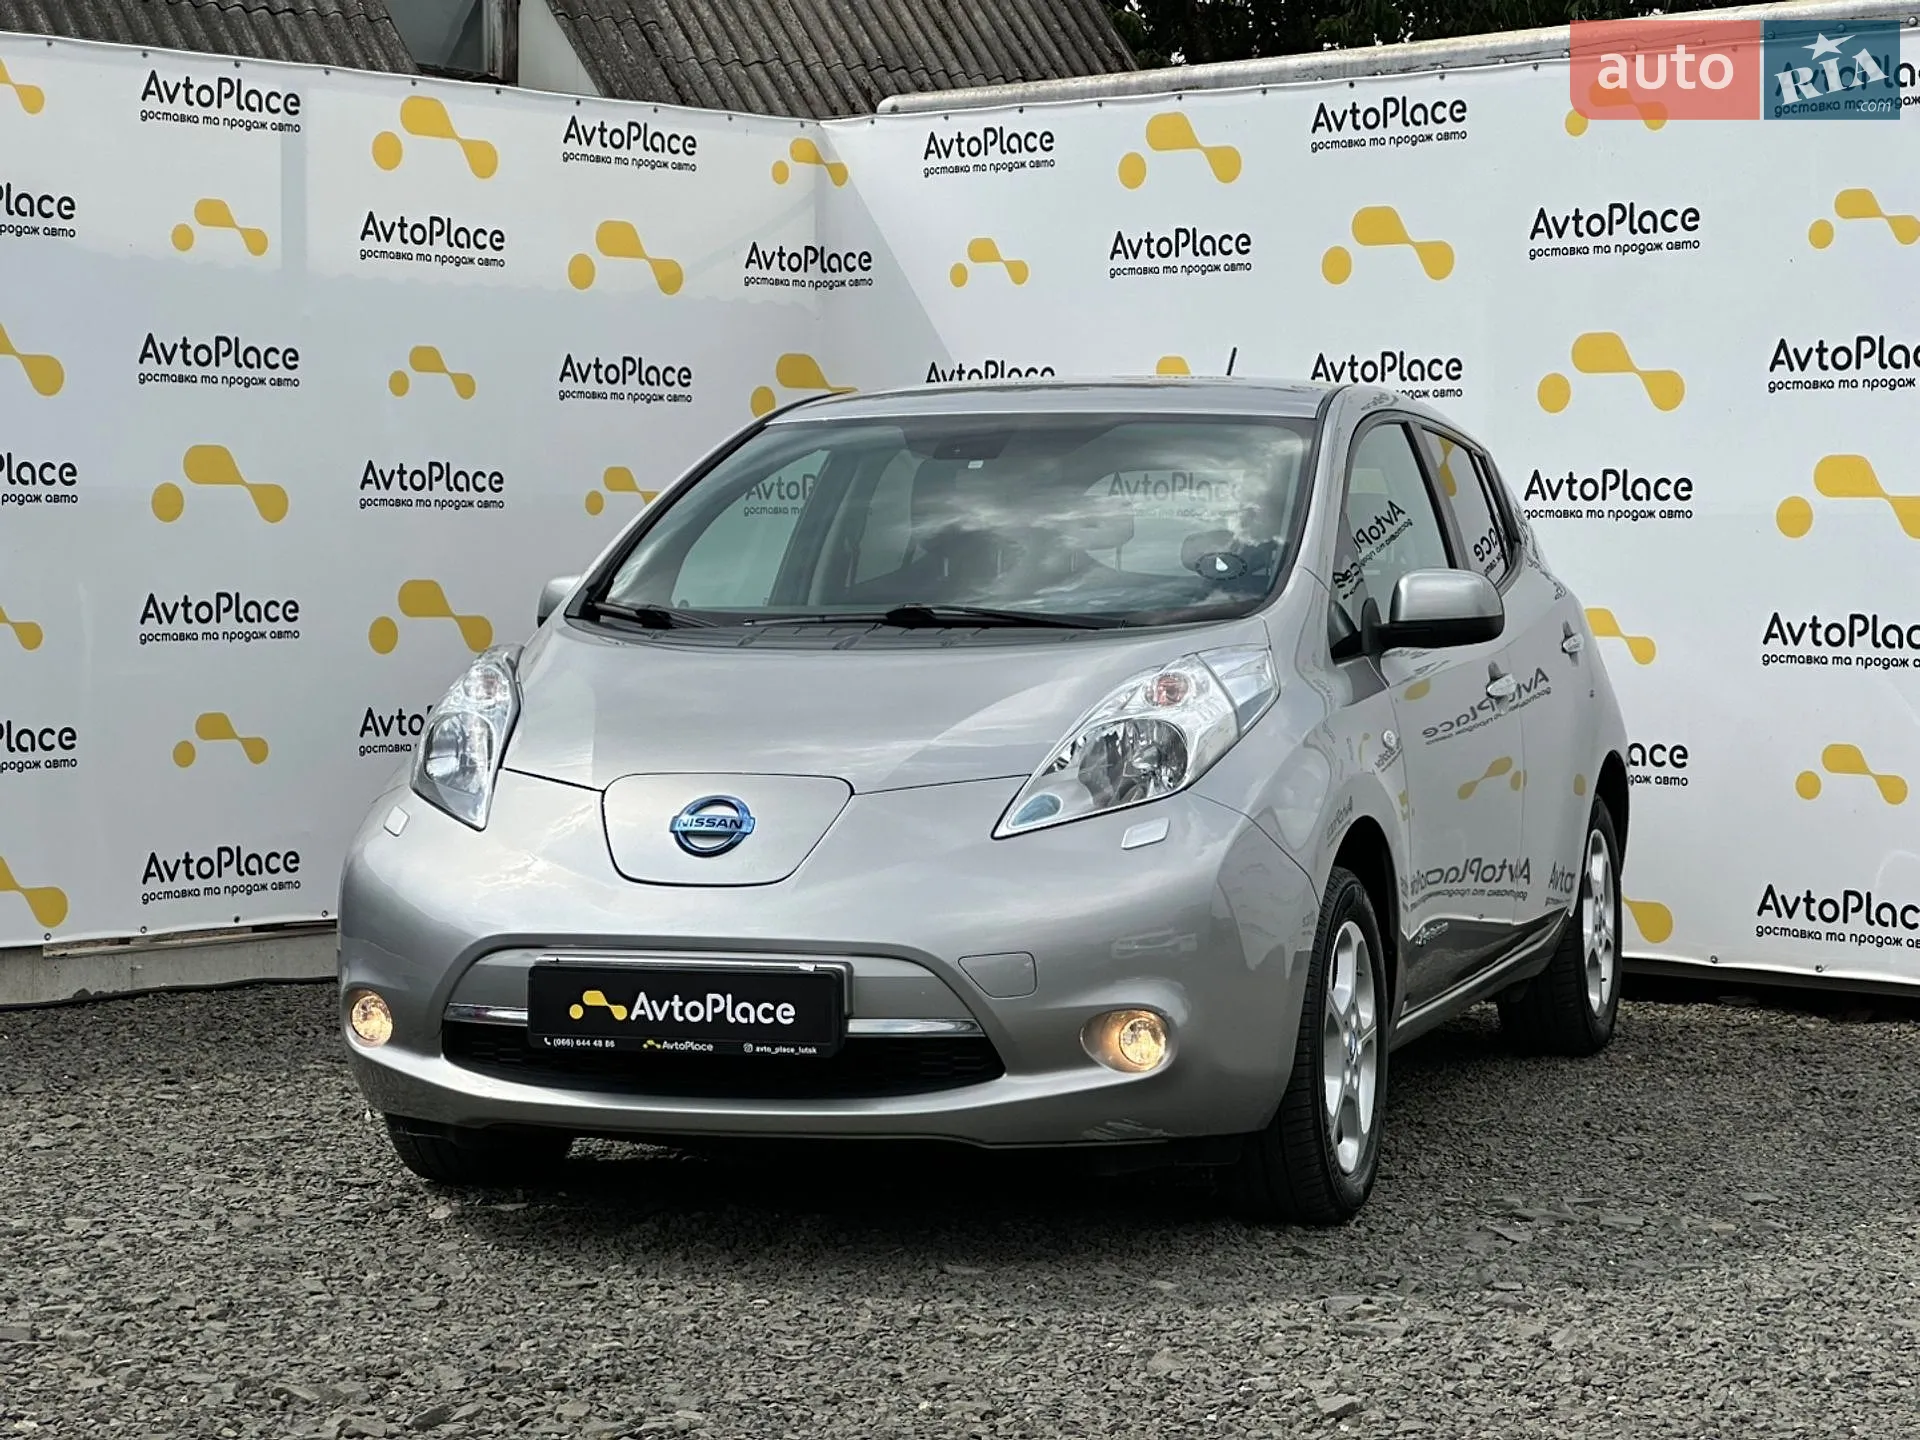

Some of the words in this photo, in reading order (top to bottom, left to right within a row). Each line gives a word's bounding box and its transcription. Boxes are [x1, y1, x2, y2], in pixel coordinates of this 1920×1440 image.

[141, 70, 300, 116] AvtoPlace
[139, 109, 199, 124] доставка
[202, 115, 219, 126] та
[222, 117, 267, 131] продаж
[269, 121, 301, 133] авто
[1311, 96, 1467, 134] AvtoPlace
[563, 115, 697, 156] AvtoPlace
[924, 126, 1054, 160] AvtoPlace
[1310, 137, 1366, 153] доставка
[1369, 136, 1386, 146] та
[1388, 133, 1433, 147] продаж
[1435, 129, 1467, 141] авто
[0, 182, 75, 220] lace
[42, 226, 75, 237] авто
[360, 211, 505, 251] AvtoPlace
[1530, 202, 1700, 240] AvtoPlace
[359, 248, 413, 261] доставка
[415, 252, 431, 262] та
[434, 254, 475, 267] продаж
[477, 257, 505, 267] авто
[745, 242, 872, 274] AvtoPlace
[1110, 227, 1251, 260] AvtoPlace
[1528, 245, 1589, 261] доставка
[1592, 244, 1611, 254] та
[1614, 241, 1663, 256] продаж
[1665, 239, 1700, 250] авто
[1109, 265, 1159, 279] доставка
[1162, 264, 1178, 274] та
[1180, 263, 1221, 275] продаж
[1222, 262, 1251, 271] авто
[139, 333, 299, 370] AvtoPlace
[137, 372, 197, 385] доставка
[200, 374, 218, 384] та
[220, 375, 266, 388] продаж
[268, 377, 299, 387] авто
[559, 353, 692, 387] AvtoPlace
[1311, 351, 1463, 383] AvtoPlace
[1431, 388, 1462, 398] авто
[1767, 379, 1834, 394] доставка
[1838, 378, 1858, 388] та
[1861, 377, 1915, 391] продаж
[0, 452, 77, 486] lace
[360, 460, 504, 493] AvtoPlace
[44, 493, 78, 503] авто
[1524, 469, 1693, 502] AvtoPlace
[359, 497, 413, 509] доставка
[415, 498, 431, 507] та
[433, 498, 474, 510] продаж
[476, 499, 504, 508] авто
[1586, 509, 1604, 518] та
[1607, 509, 1655, 521] продаж
[1658, 509, 1693, 518] авто
[140, 592, 299, 625] AvtoPlace
[138, 631, 198, 645] доставка
[201, 631, 219, 640] та
[222, 630, 266, 643] продаж
[269, 629, 299, 639] авто
[1761, 653, 1828, 666] доставка
[1831, 655, 1852, 666] та
[1855, 656, 1909, 670] продаж
[359, 705, 433, 738] Avto
[0, 720, 77, 753] lace
[358, 743, 411, 756] доставка
[43, 758, 77, 768] авто
[1654, 775, 1688, 786] авто
[677, 817, 743, 829] NISSAN
[142, 846, 300, 885] AvtoPlace
[141, 887, 200, 905] доставка
[203, 886, 220, 896] та
[223, 882, 268, 896] продаж
[270, 879, 301, 890] авто
[1757, 884, 1920, 930] AvtoPlac
[1755, 924, 1822, 940] доставка
[1825, 931, 1846, 942] та
[1849, 932, 1902, 948] продаж
[630, 991, 796, 1025] AvtoPlace
[662, 1041, 714, 1052] AvtoPlace
